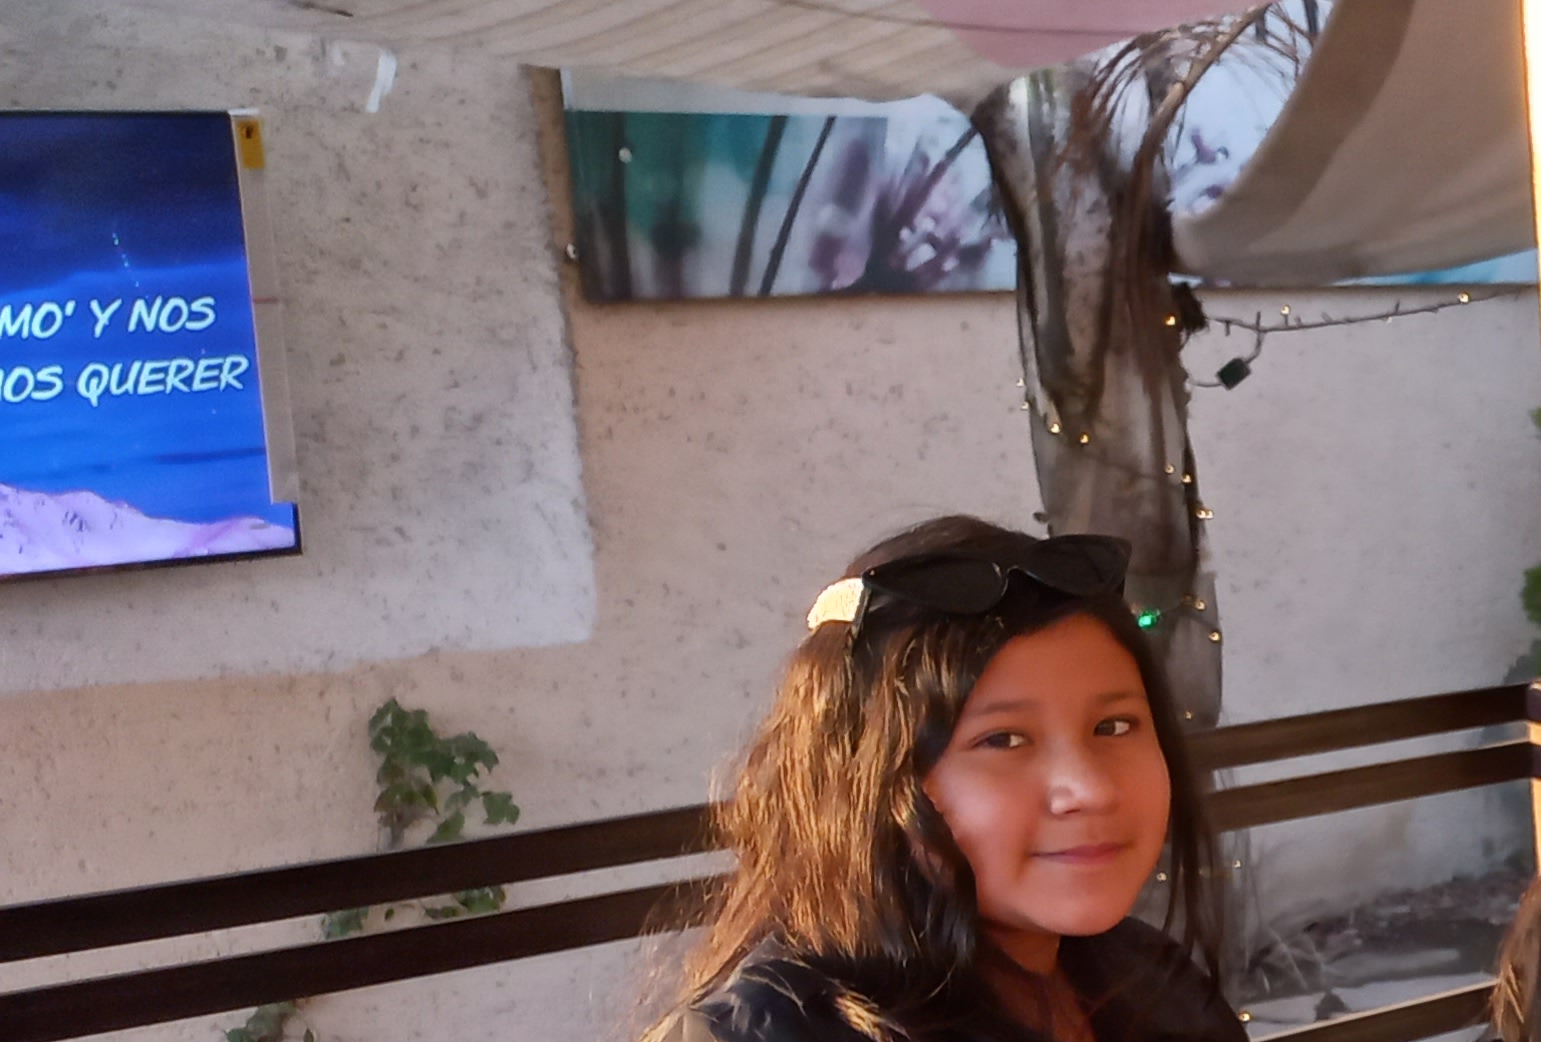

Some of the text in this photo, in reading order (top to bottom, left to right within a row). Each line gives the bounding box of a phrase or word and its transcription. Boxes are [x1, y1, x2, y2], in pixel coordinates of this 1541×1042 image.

[89, 298, 122, 338] Y
[128, 295, 216, 334] NOS
[0, 354, 250, 408] OS QUERER
